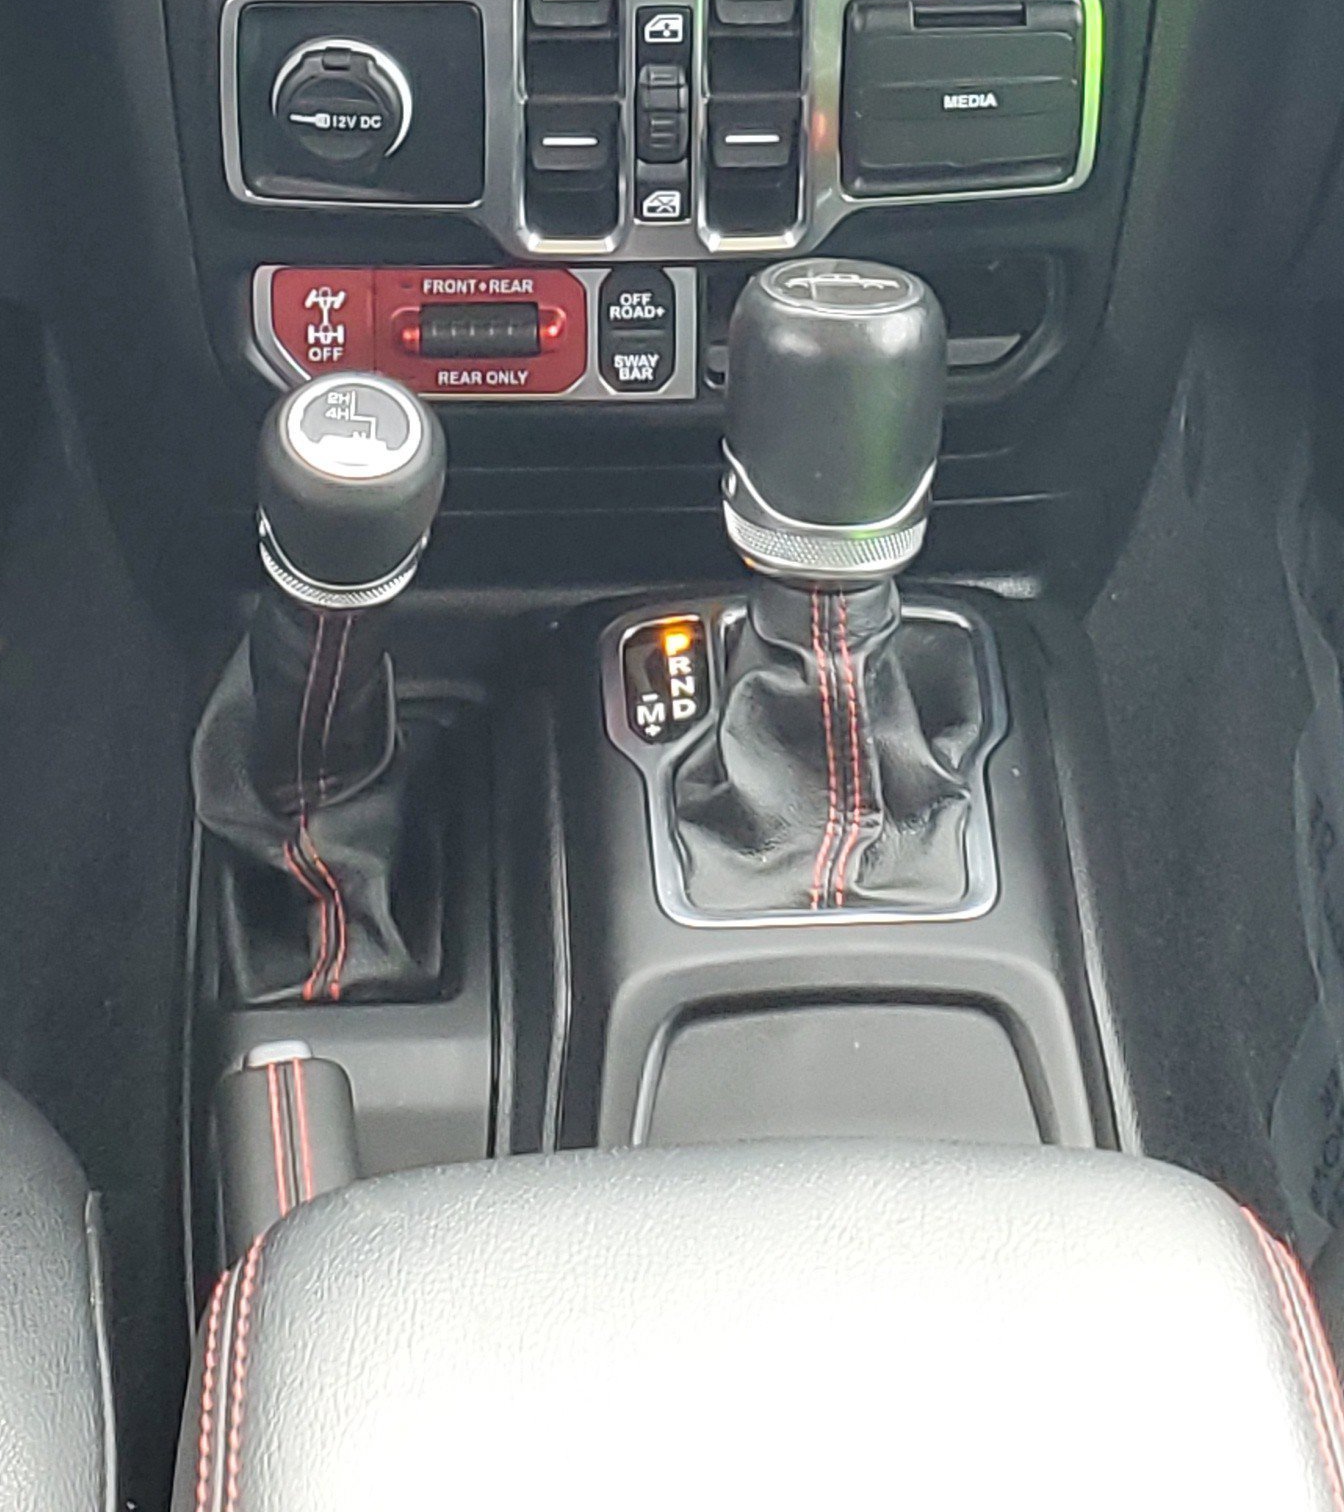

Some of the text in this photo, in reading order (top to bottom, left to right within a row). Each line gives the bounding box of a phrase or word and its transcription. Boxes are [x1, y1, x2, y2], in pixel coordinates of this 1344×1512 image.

[944, 93, 997, 109] MEDIA
[333, 116, 381, 128] 12V DC
[620, 293, 651, 306] OFF
[309, 345, 343, 361] OFF
[614, 355, 658, 369] SWAY
[438, 370, 529, 386] REAR ONLY
[619, 367, 653, 381] BAR
[327, 392, 350, 405] 2H
[325, 407, 349, 420] 4H
[666, 634, 688, 655] P
[669, 657, 691, 676] R
[671, 677, 694, 697] N
[637, 701, 665, 725] M
[673, 699, 697, 719] D
